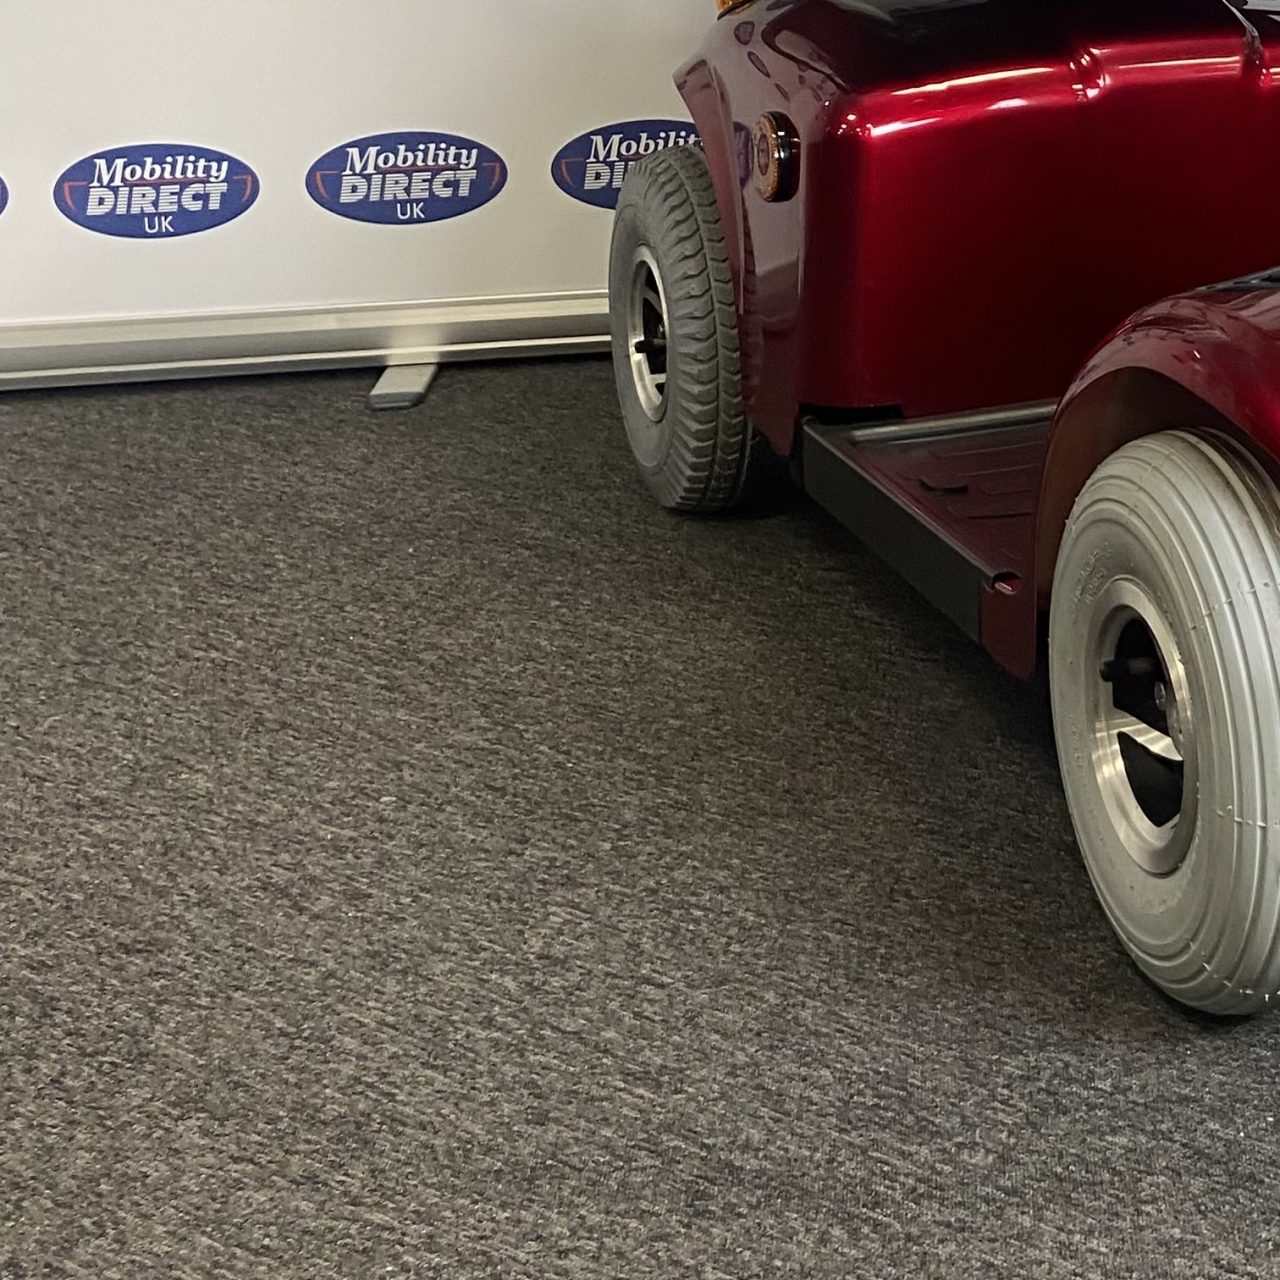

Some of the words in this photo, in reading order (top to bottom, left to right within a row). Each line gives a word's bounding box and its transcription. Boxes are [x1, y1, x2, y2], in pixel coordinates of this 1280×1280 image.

[89, 155, 228, 187] Mobility
[342, 143, 478, 176] Mobility
[86, 183, 228, 216] DIRECT
[339, 170, 477, 203] DIRECT
[144, 216, 174, 233] UK
[397, 202, 425, 219] UK
